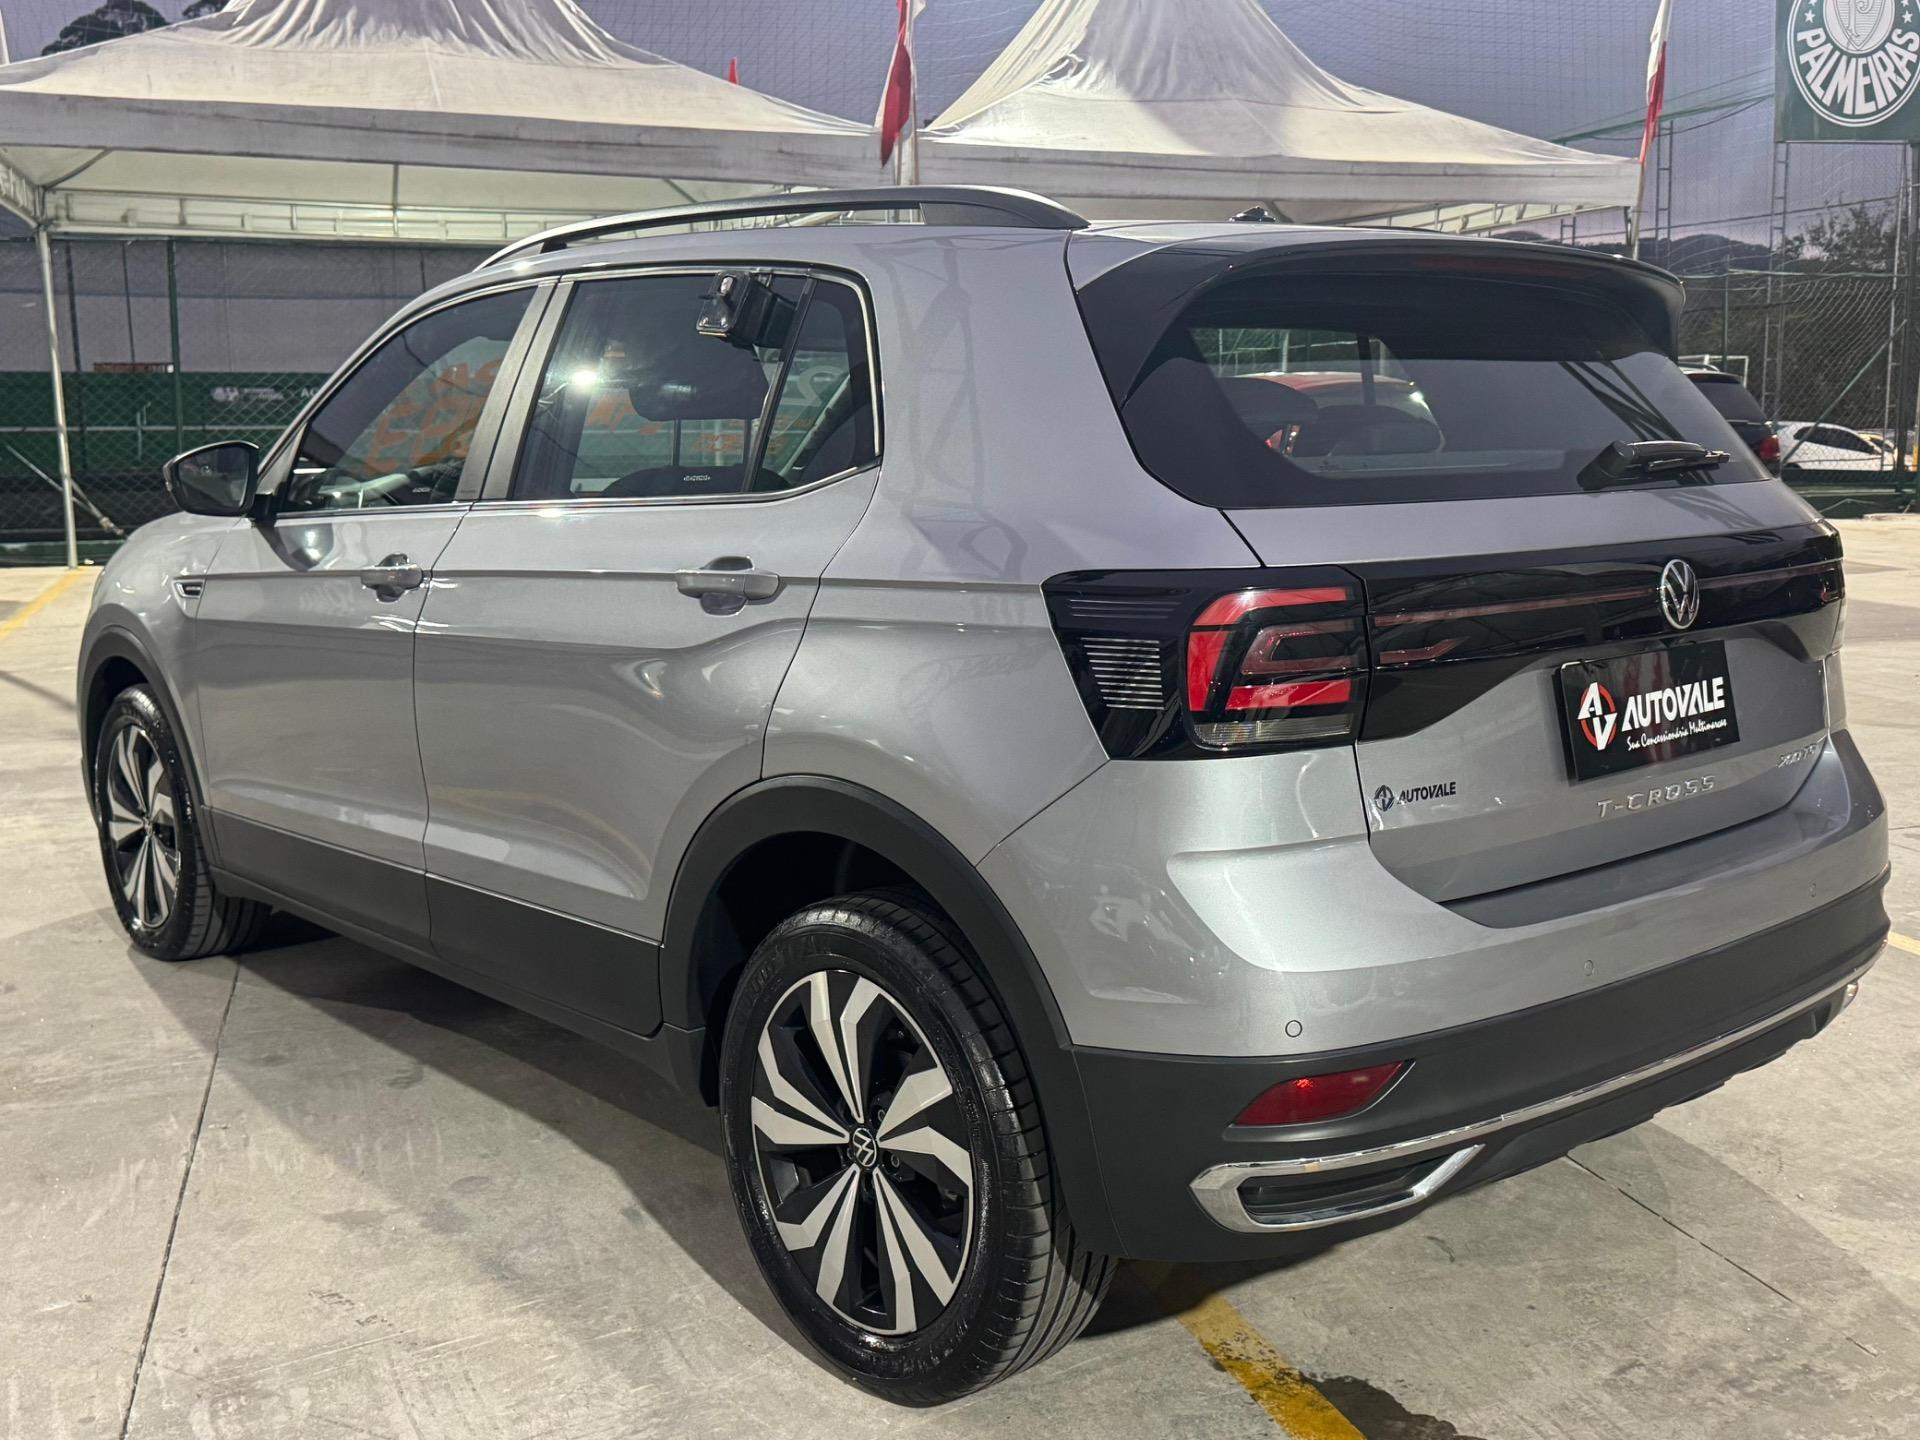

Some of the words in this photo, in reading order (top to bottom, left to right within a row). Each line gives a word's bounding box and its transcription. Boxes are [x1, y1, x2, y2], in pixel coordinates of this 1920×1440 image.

[1796, 27, 1920, 116] PALMEIRAS
[1621, 676, 1726, 732] AUTOVALE
[1396, 781, 1457, 805] AUTOVALE
[1597, 775, 1716, 819] T-CROSS
